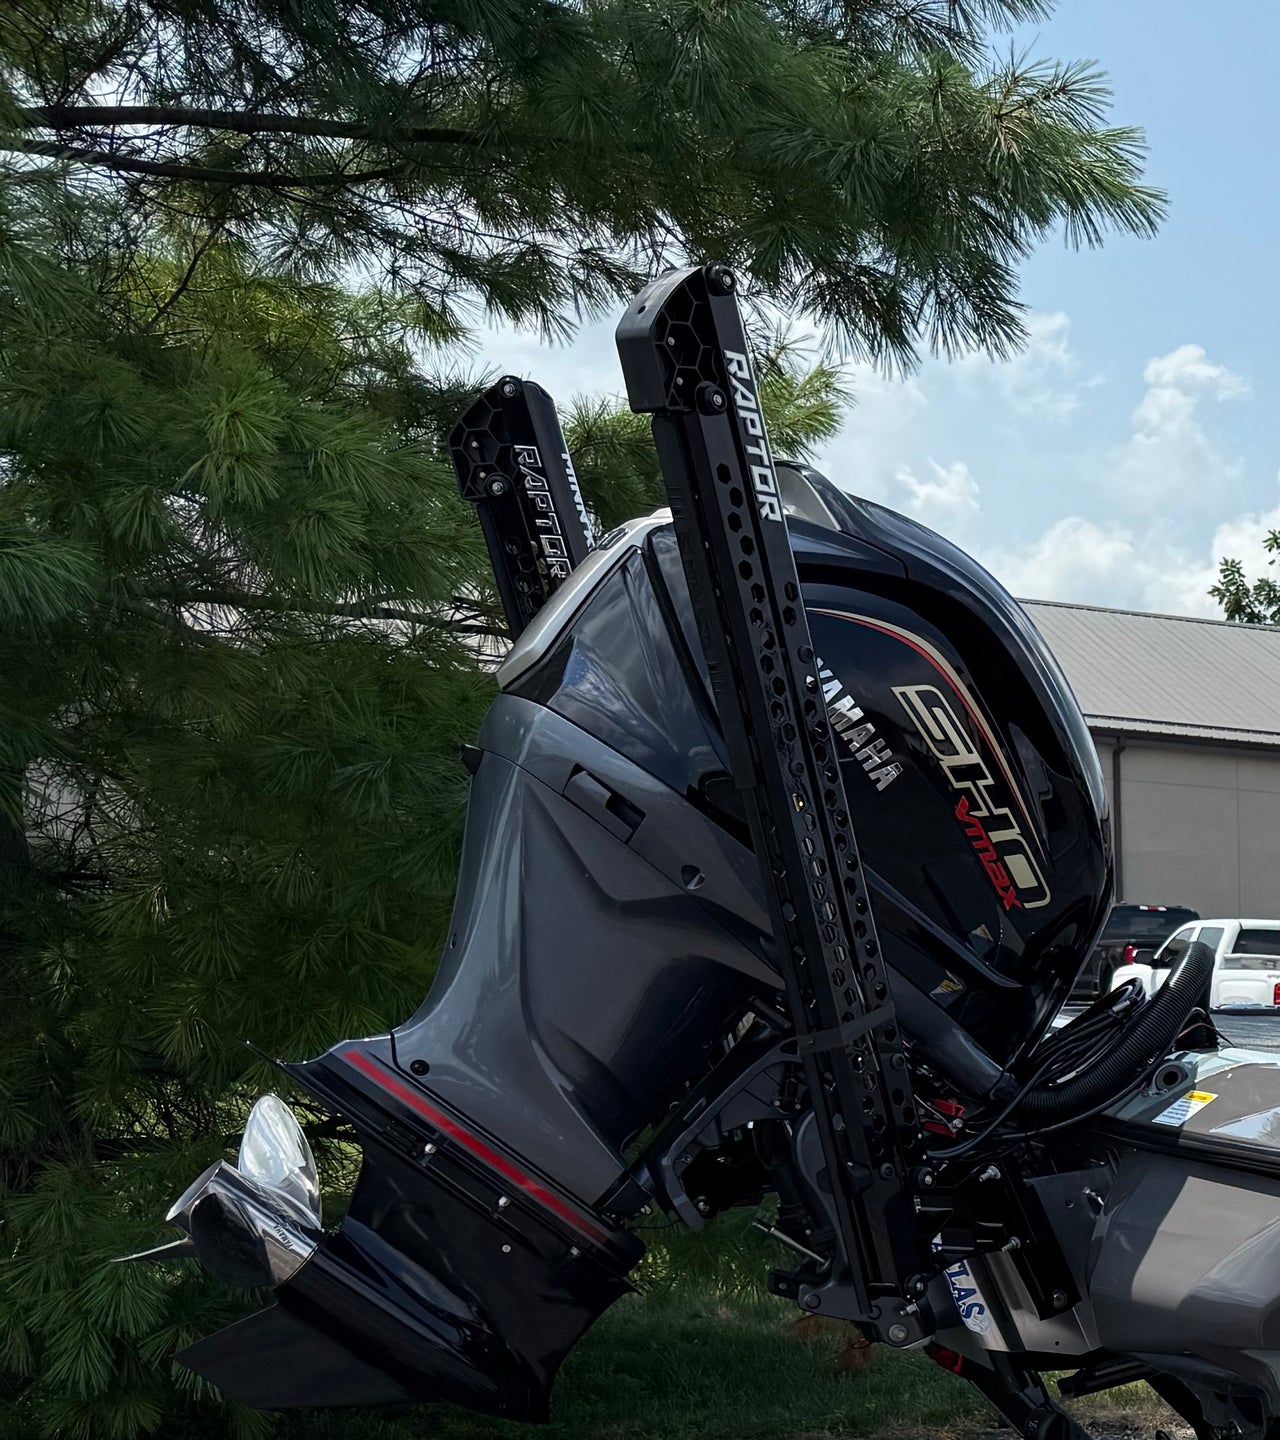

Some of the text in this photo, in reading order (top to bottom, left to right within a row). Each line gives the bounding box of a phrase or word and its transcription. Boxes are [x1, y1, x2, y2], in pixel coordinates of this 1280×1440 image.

[513, 444, 574, 579] RAPTOR
[724, 350, 783, 522] RAPTOR
[890, 684, 1051, 909] SHO
